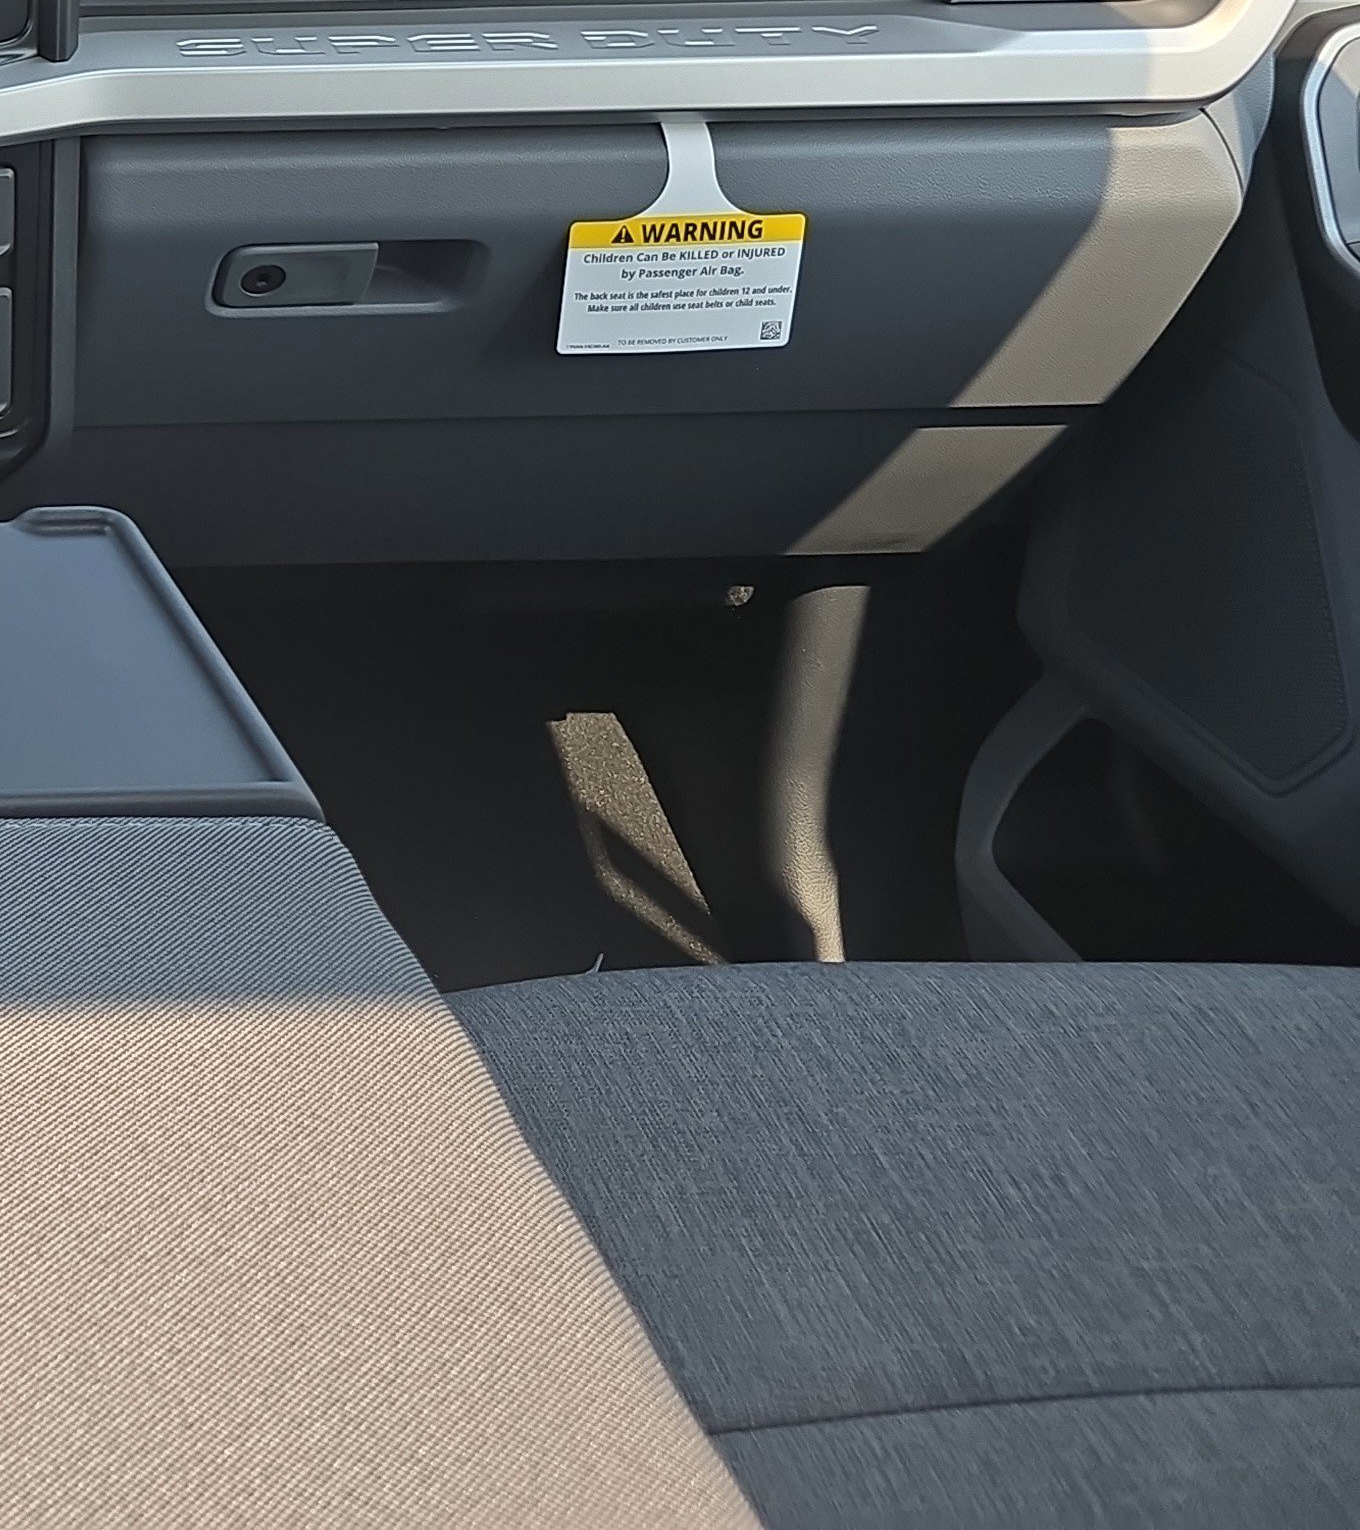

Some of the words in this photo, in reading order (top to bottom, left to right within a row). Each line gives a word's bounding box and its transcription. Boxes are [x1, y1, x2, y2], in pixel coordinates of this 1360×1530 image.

[176, 31, 560, 58] SUPER
[580, 23, 881, 52] DUTY
[642, 219, 764, 244] WARNING
[583, 253, 633, 264] Children
[636, 252, 659, 262] Can
[661, 252, 677, 261] Be
[679, 250, 719, 261] KILLED
[722, 250, 735, 259] or
[737, 247, 785, 260] INJURED
[621, 269, 636, 281] by
[638, 268, 698, 280] Passenger
[699, 266, 716, 276] Air
[720, 265, 744, 277] Bag.
[574, 292, 589, 301] The
[590, 292, 607, 300] back
[610, 292, 625, 300] seat
[628, 291, 635, 300] is
[636, 291, 648, 299] the
[650, 290, 673, 299] safest
[674, 289, 693, 300] place
[696, 288, 707, 297] for
[709, 287, 739, 296] children
[741, 287, 750, 295] 12
[752, 286, 767, 295] and
[768, 285, 793, 294] under.
[587, 304, 609, 312] Make
[629, 303, 638, 312] all
[641, 302, 671, 311] children
[687, 301, 703, 309] seat
[705, 300, 723, 309] belts
[735, 298, 753, 307] child
[755, 298, 776, 306] seats.
[637, 337, 667, 345] REMOVED
[677, 336, 710, 344] CUSTOMER
